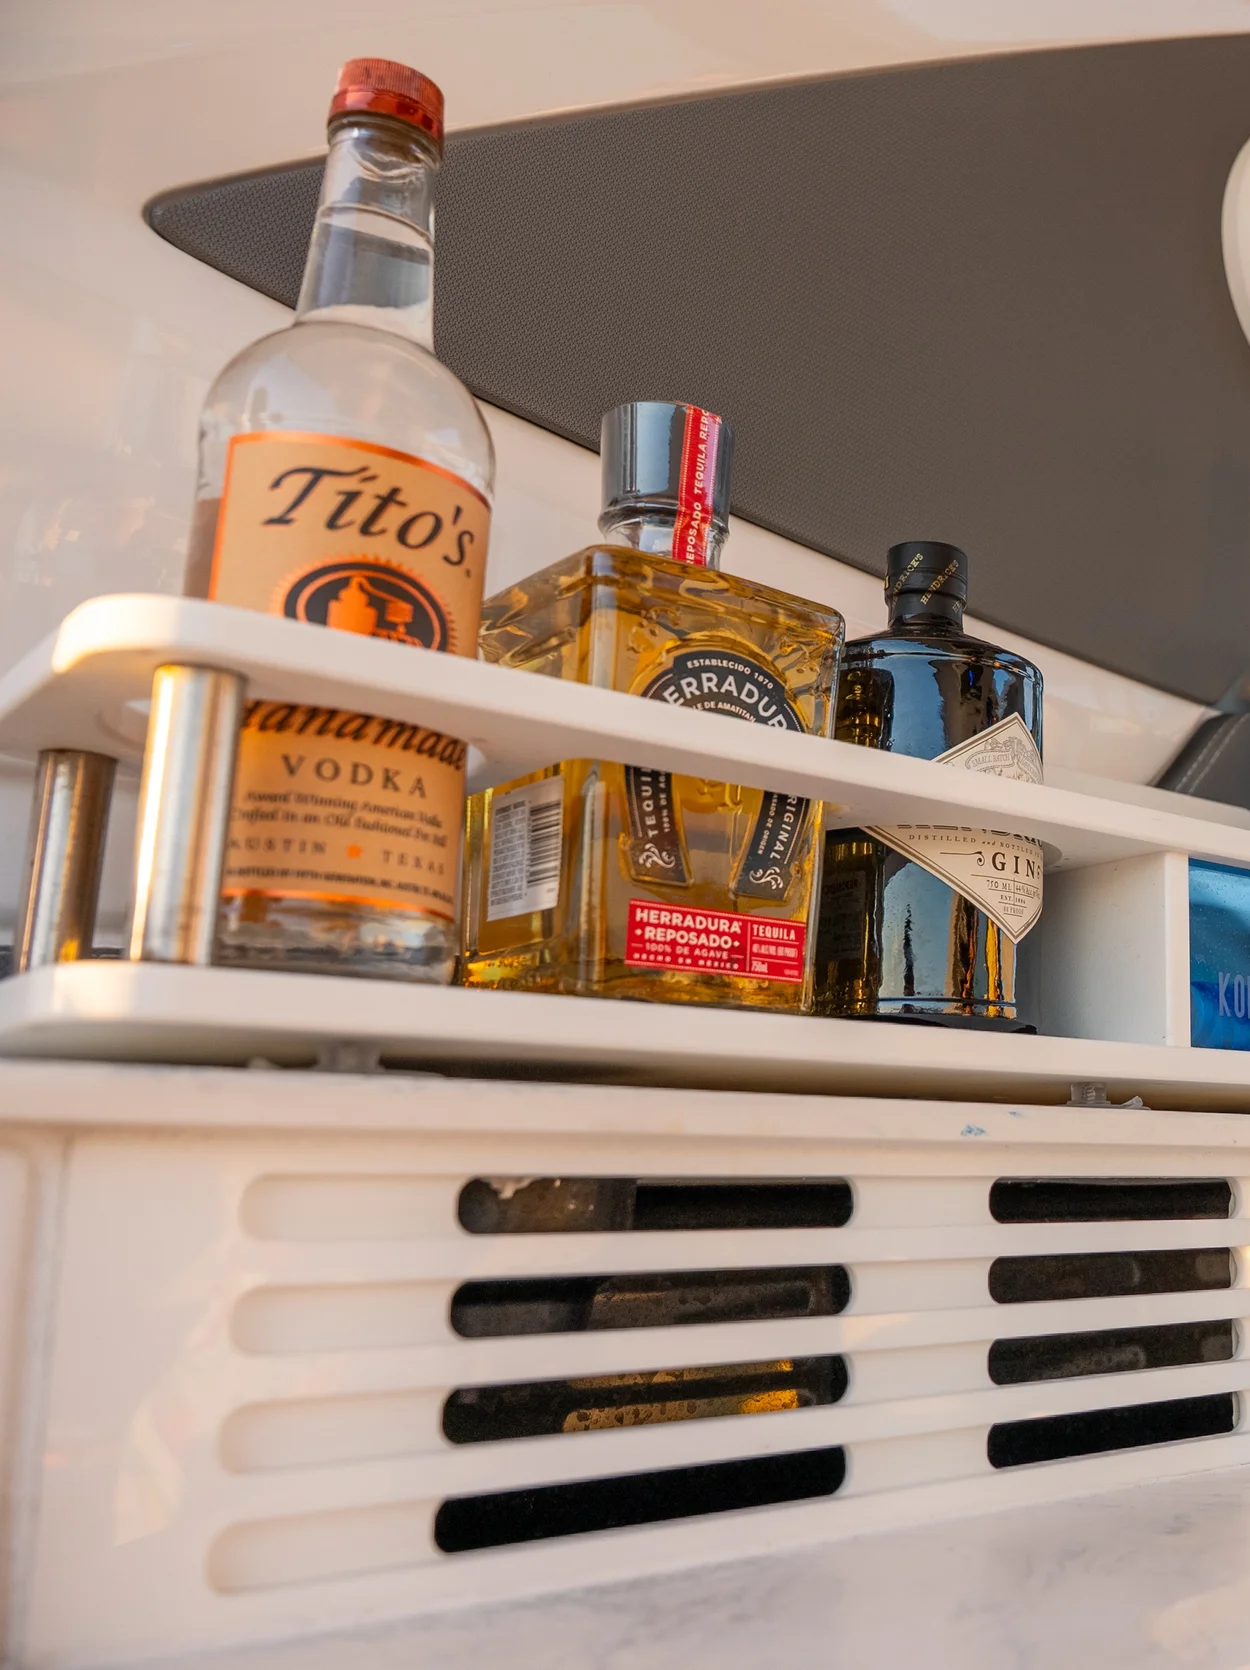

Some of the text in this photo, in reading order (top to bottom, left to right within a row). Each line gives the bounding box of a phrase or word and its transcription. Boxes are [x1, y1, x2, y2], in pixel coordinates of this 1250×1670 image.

[694, 444, 706, 494] TEQUILA
[262, 465, 475, 567] Tito's
[920, 559, 959, 605] HENDRICK'S
[687, 658, 774, 690] ESTABLECIDO 1870
[662, 672, 788, 730] ERRADUR
[704, 701, 716, 709] DE
[281, 754, 427, 798] VODKA
[640, 767, 659, 838] TEQUI
[769, 794, 798, 859] RIGINAL
[229, 837, 327, 855] AUSTIN
[909, 834, 976, 844] DISTILLED
[1000, 842, 1033, 855] BOTTLED
[991, 851, 1036, 878] GIN
[986, 879, 999, 889] 750
[1001, 881, 1012, 891] ML
[635, 908, 742, 934] HERRADURA
[752, 924, 796, 941] TEQUILA
[644, 927, 733, 949] REPOSADO
[676, 945, 690, 955] DE
[694, 948, 729, 960] AGAVE
